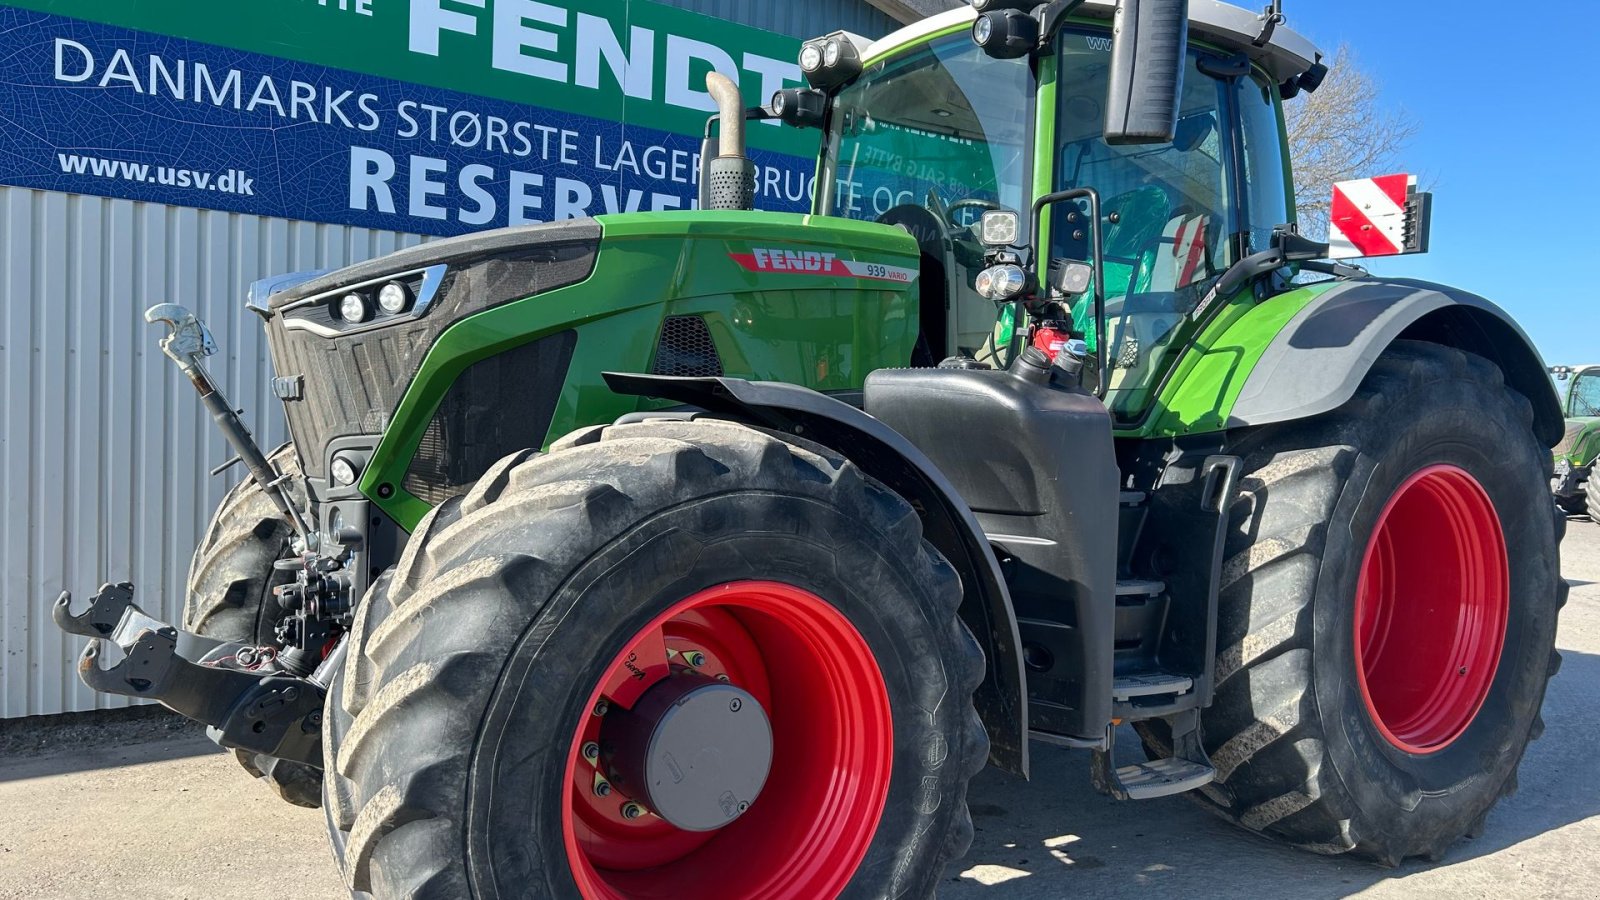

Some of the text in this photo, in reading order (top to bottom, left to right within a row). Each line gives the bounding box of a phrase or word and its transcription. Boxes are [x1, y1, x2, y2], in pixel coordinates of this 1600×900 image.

[54, 38, 380, 132] DANMARKS
[397, 100, 580, 166] STØRSTE
[407, 0, 801, 128] FENDT
[57, 152, 254, 196] www.usv.dk
[752, 247, 908, 281] FENDT 939 VARIO
